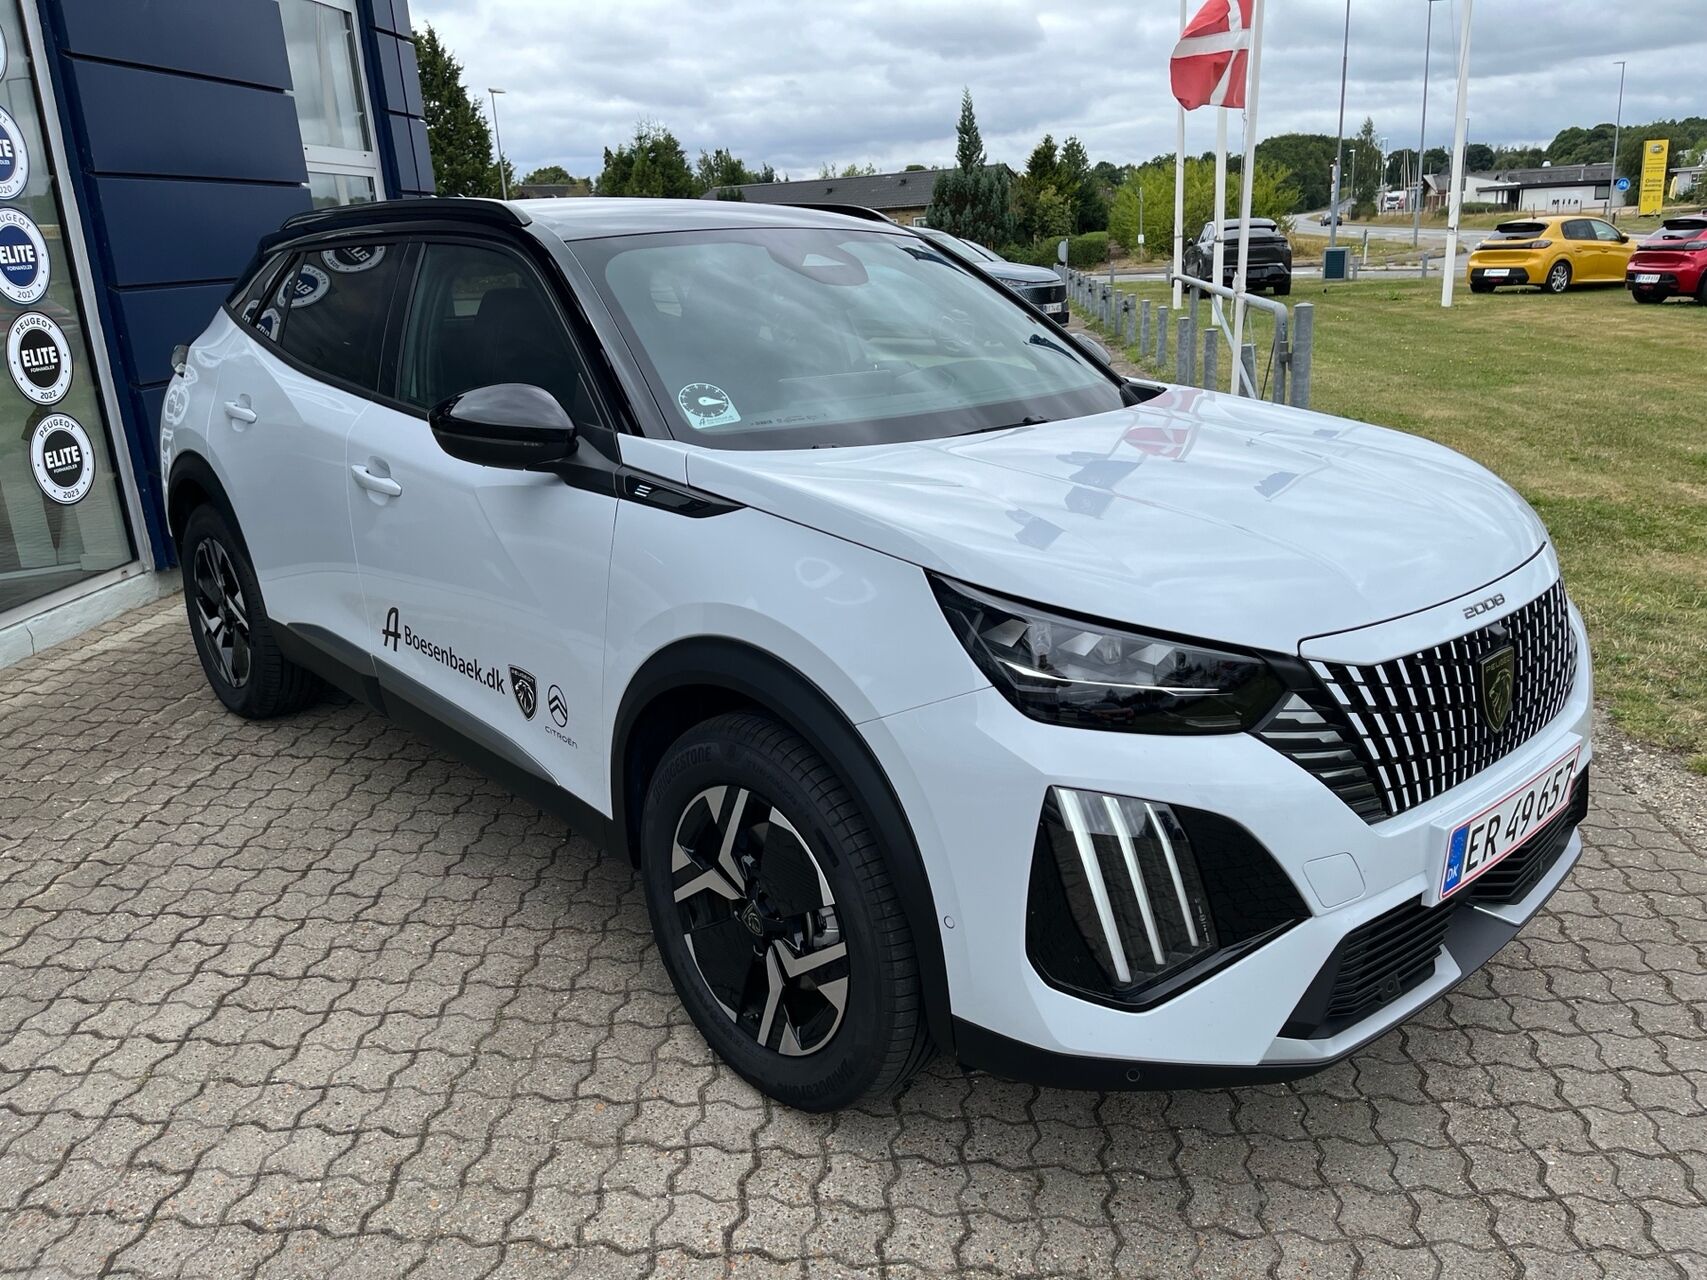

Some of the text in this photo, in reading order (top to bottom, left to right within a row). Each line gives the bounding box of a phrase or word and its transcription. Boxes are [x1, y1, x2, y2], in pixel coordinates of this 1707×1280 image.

[0, 213, 31, 230] UGEOT
[0, 244, 35, 264] ELITE
[17, 289, 35, 299] 2021
[15, 317, 53, 336] PEUGEOT
[21, 346, 58, 368] ELITE
[40, 389, 57, 400] 2022
[38, 418, 76, 438] PEUGEOT
[44, 445, 81, 469] ELITE
[62, 488, 80, 499] 2023
[1462, 592, 1506, 620] 2008
[404, 624, 506, 695] Boesenbaek.dk
[1446, 757, 1576, 883] DK ER 49 657
